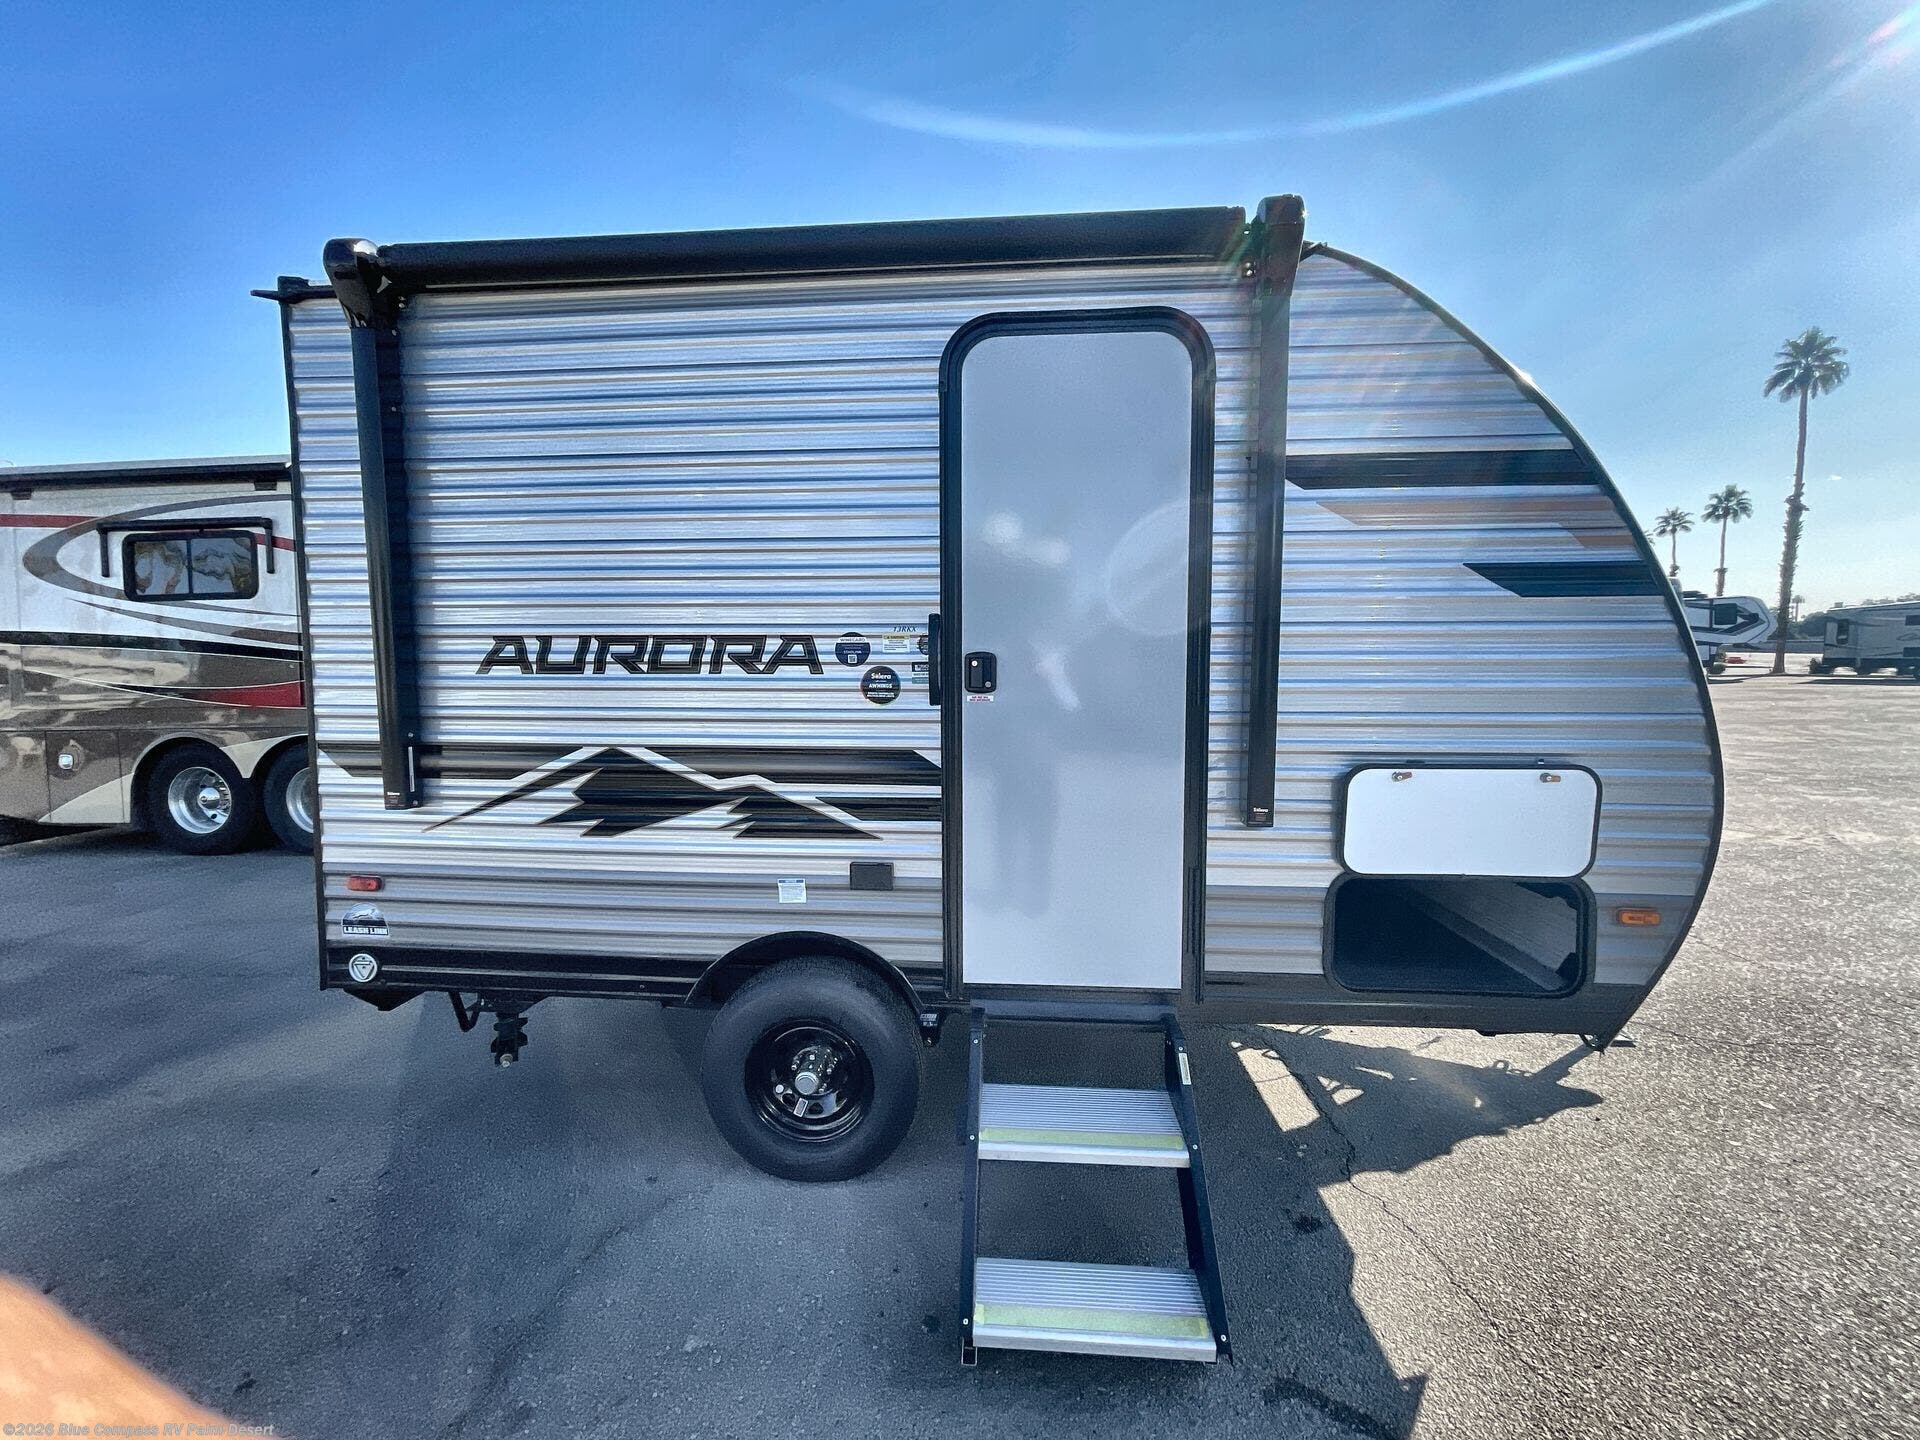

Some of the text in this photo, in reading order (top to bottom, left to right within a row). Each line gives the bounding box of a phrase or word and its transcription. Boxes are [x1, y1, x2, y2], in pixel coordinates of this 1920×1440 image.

[475, 634, 825, 675] AURORA
[871, 672, 892, 680] Solera
[343, 926, 388, 935] LEASH LINK
